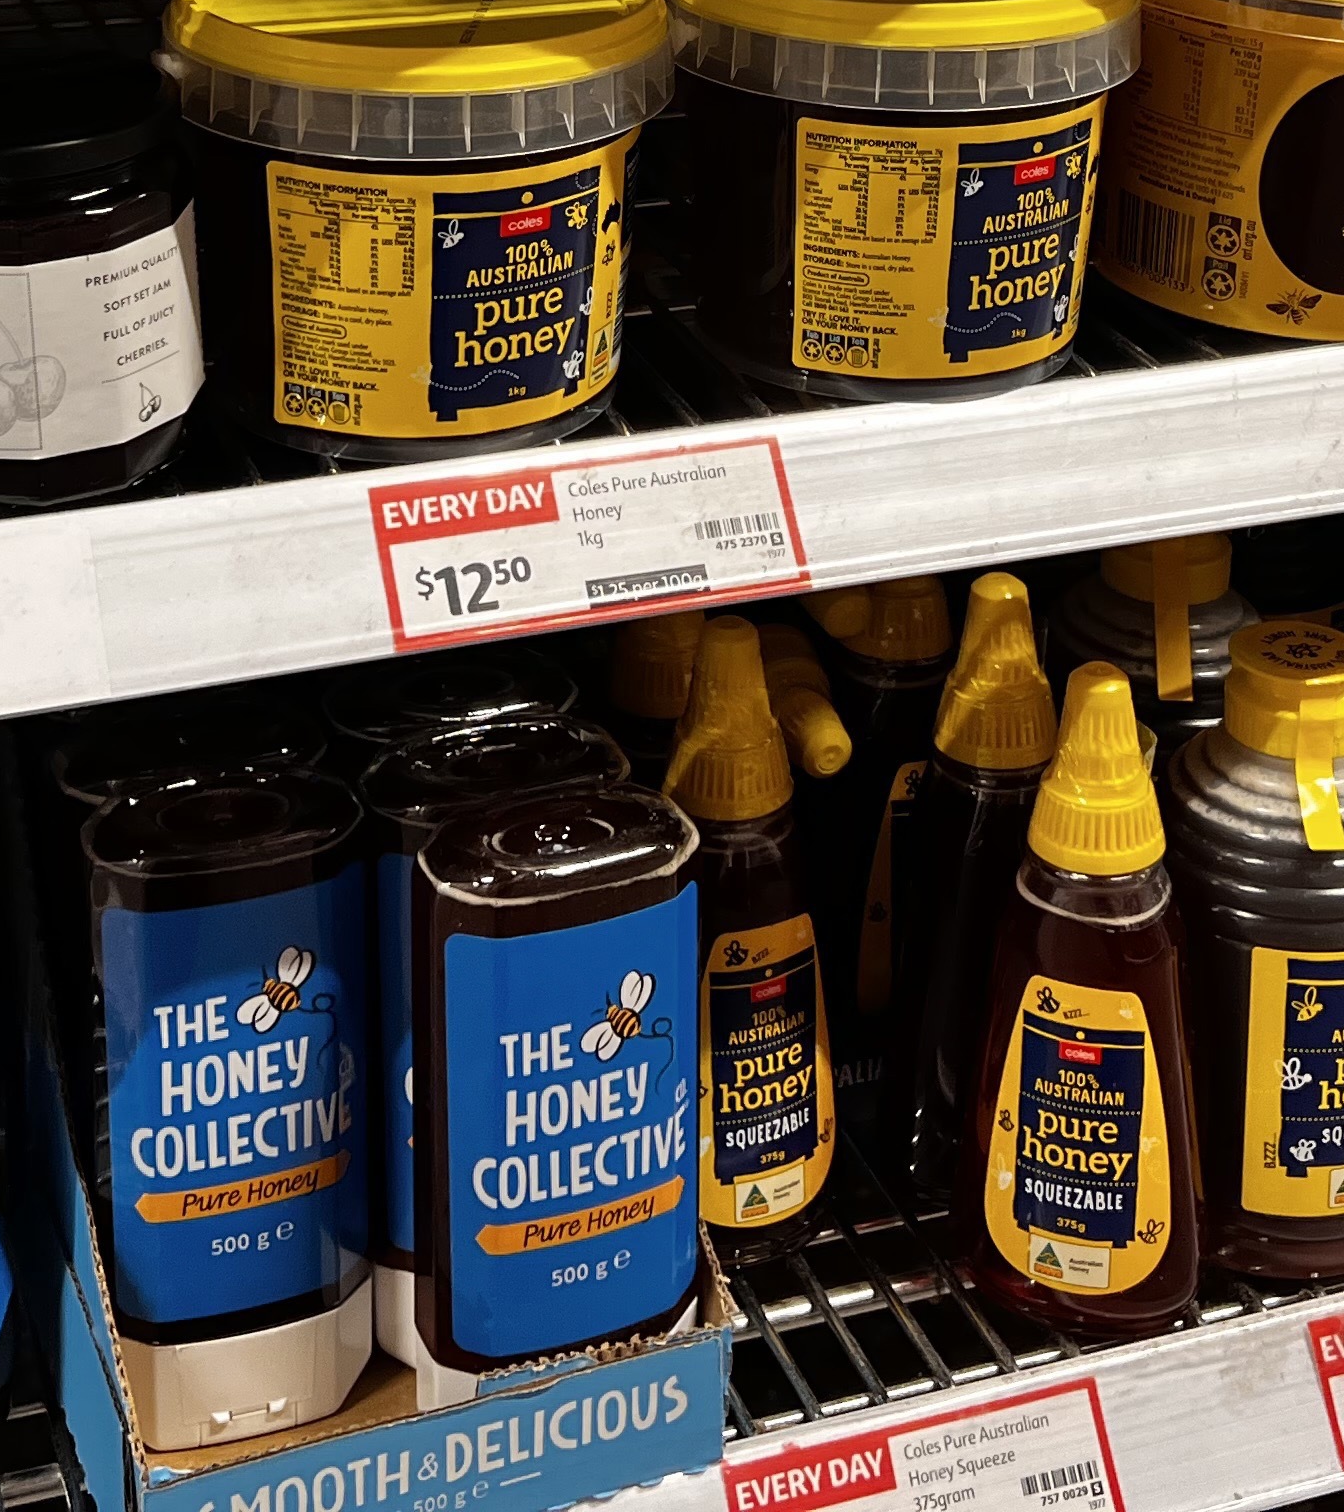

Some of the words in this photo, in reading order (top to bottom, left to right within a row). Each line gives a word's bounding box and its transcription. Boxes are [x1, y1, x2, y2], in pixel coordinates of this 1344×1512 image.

[986, 232, 1060, 271] pure
[969, 262, 1067, 312] honey
[382, 491, 478, 530] EVERY
[486, 482, 545, 514] DAY
[567, 479, 610, 498] Coles
[612, 475, 647, 493] Pure
[651, 466, 727, 487] Australian
[500, 1024, 574, 1077] THE
[505, 1062, 649, 1146] HONEY
[1034, 1077, 1125, 1106] AUSTRALIAN
[1036, 1109, 1118, 1143] pure
[472, 1115, 687, 1210] COLLECTIVE
[1024, 1128, 1132, 1179] honey
[522, 1222, 583, 1248] Pure
[585, 1197, 655, 1235] Honey
[444, 1376, 689, 1483] DELICIOUS
